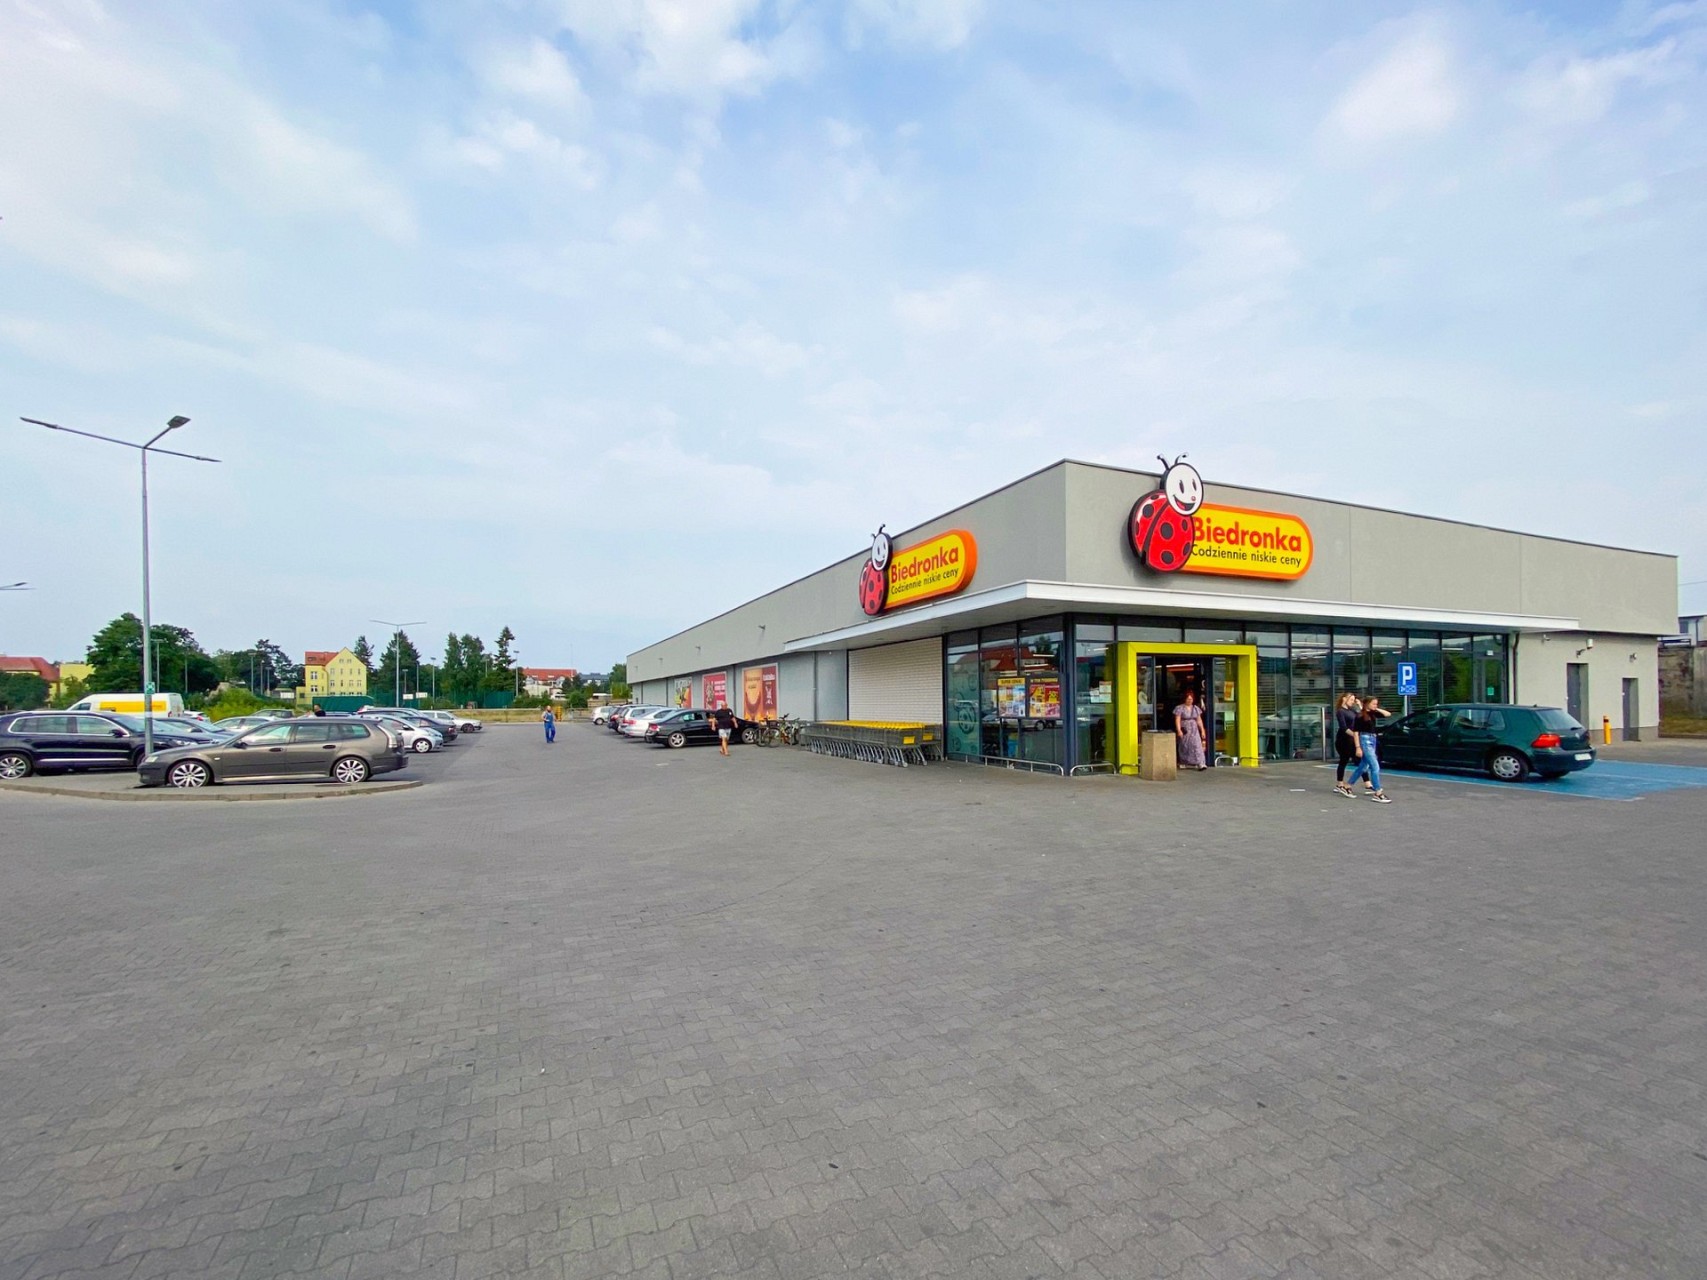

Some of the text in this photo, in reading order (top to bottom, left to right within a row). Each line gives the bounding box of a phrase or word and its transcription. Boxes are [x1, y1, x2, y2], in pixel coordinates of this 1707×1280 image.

[1193, 517, 1302, 552] Biedronka
[890, 546, 959, 584] Biedronka
[1191, 544, 1302, 568] Codziennie niskie ceny
[890, 568, 959, 595] Codziennie niskie ceny
[1402, 665, 1413, 686] P
